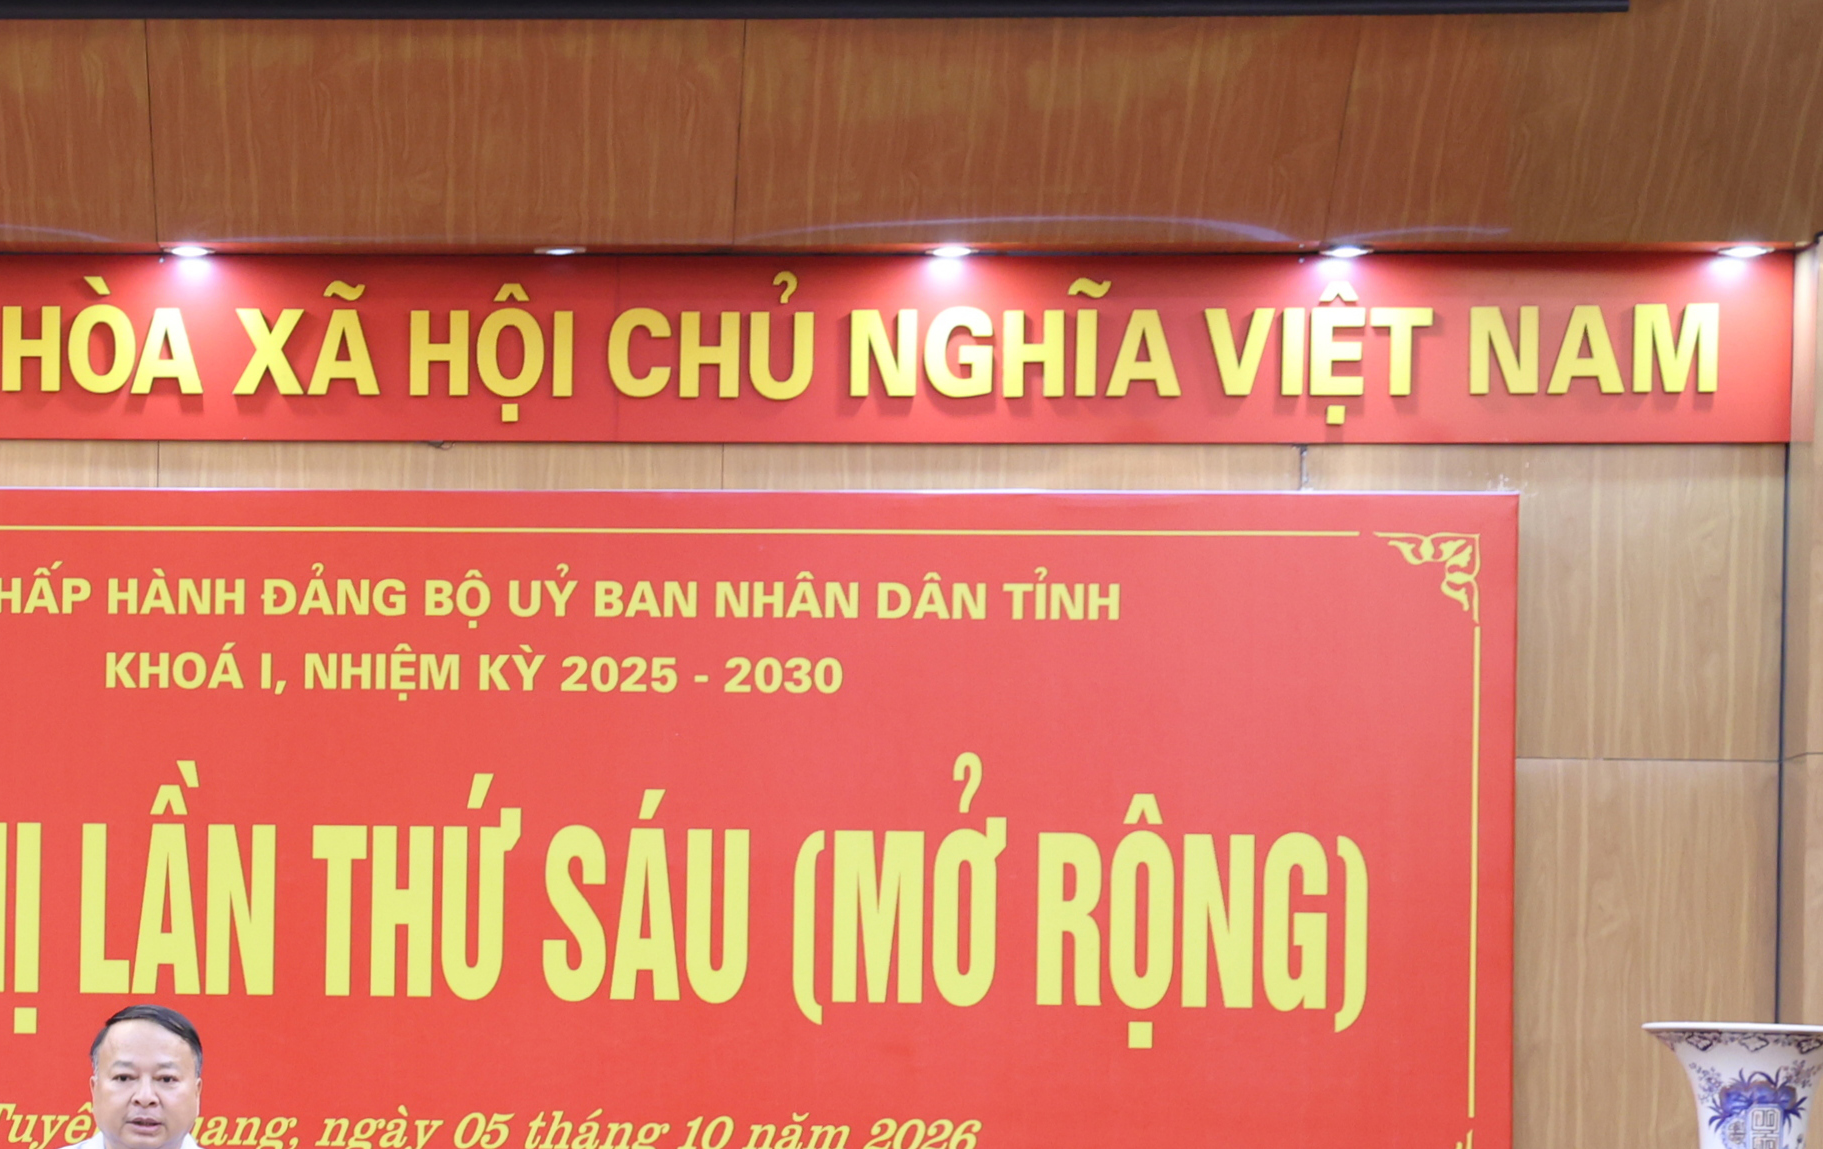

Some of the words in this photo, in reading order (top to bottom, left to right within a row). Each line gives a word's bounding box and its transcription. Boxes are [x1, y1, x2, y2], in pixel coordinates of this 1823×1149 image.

[1, 276, 204, 396] HÒA
[232, 281, 380, 396] XÃ
[409, 283, 574, 422] HỘI
[607, 273, 815, 400] CHỦ
[849, 279, 1182, 398] NGHĨA
[1205, 281, 1435, 424] VIỆT
[1468, 303, 1720, 395] NAM
[107, 567, 246, 616] HÀNH
[260, 562, 407, 617] ĐẢNG
[424, 569, 492, 629] BỘ
[508, 563, 578, 618] UỶ
[594, 580, 698, 619] BAN
[715, 571, 860, 619] NHÂN
[877, 571, 987, 620] DÂN
[1003, 566, 1121, 621] TỈNH
[105, 642, 245, 690] KHOÁ
[260, 652, 287, 695] I,
[304, 643, 461, 702] NHIỆM
[478, 644, 545, 692] KỲ
[560, 655, 679, 694] 2025
[694, 674, 710, 683] -
[724, 656, 844, 694] 2030
[79, 759, 277, 997] LẦN
[312, 772, 522, 1001] THỨ
[542, 788, 751, 1005] SÁU
[791, 752, 1008, 1025] (MỞ
[1036, 793, 1369, 1050] RỘNG)
[453, 1112, 514, 1149] 05
